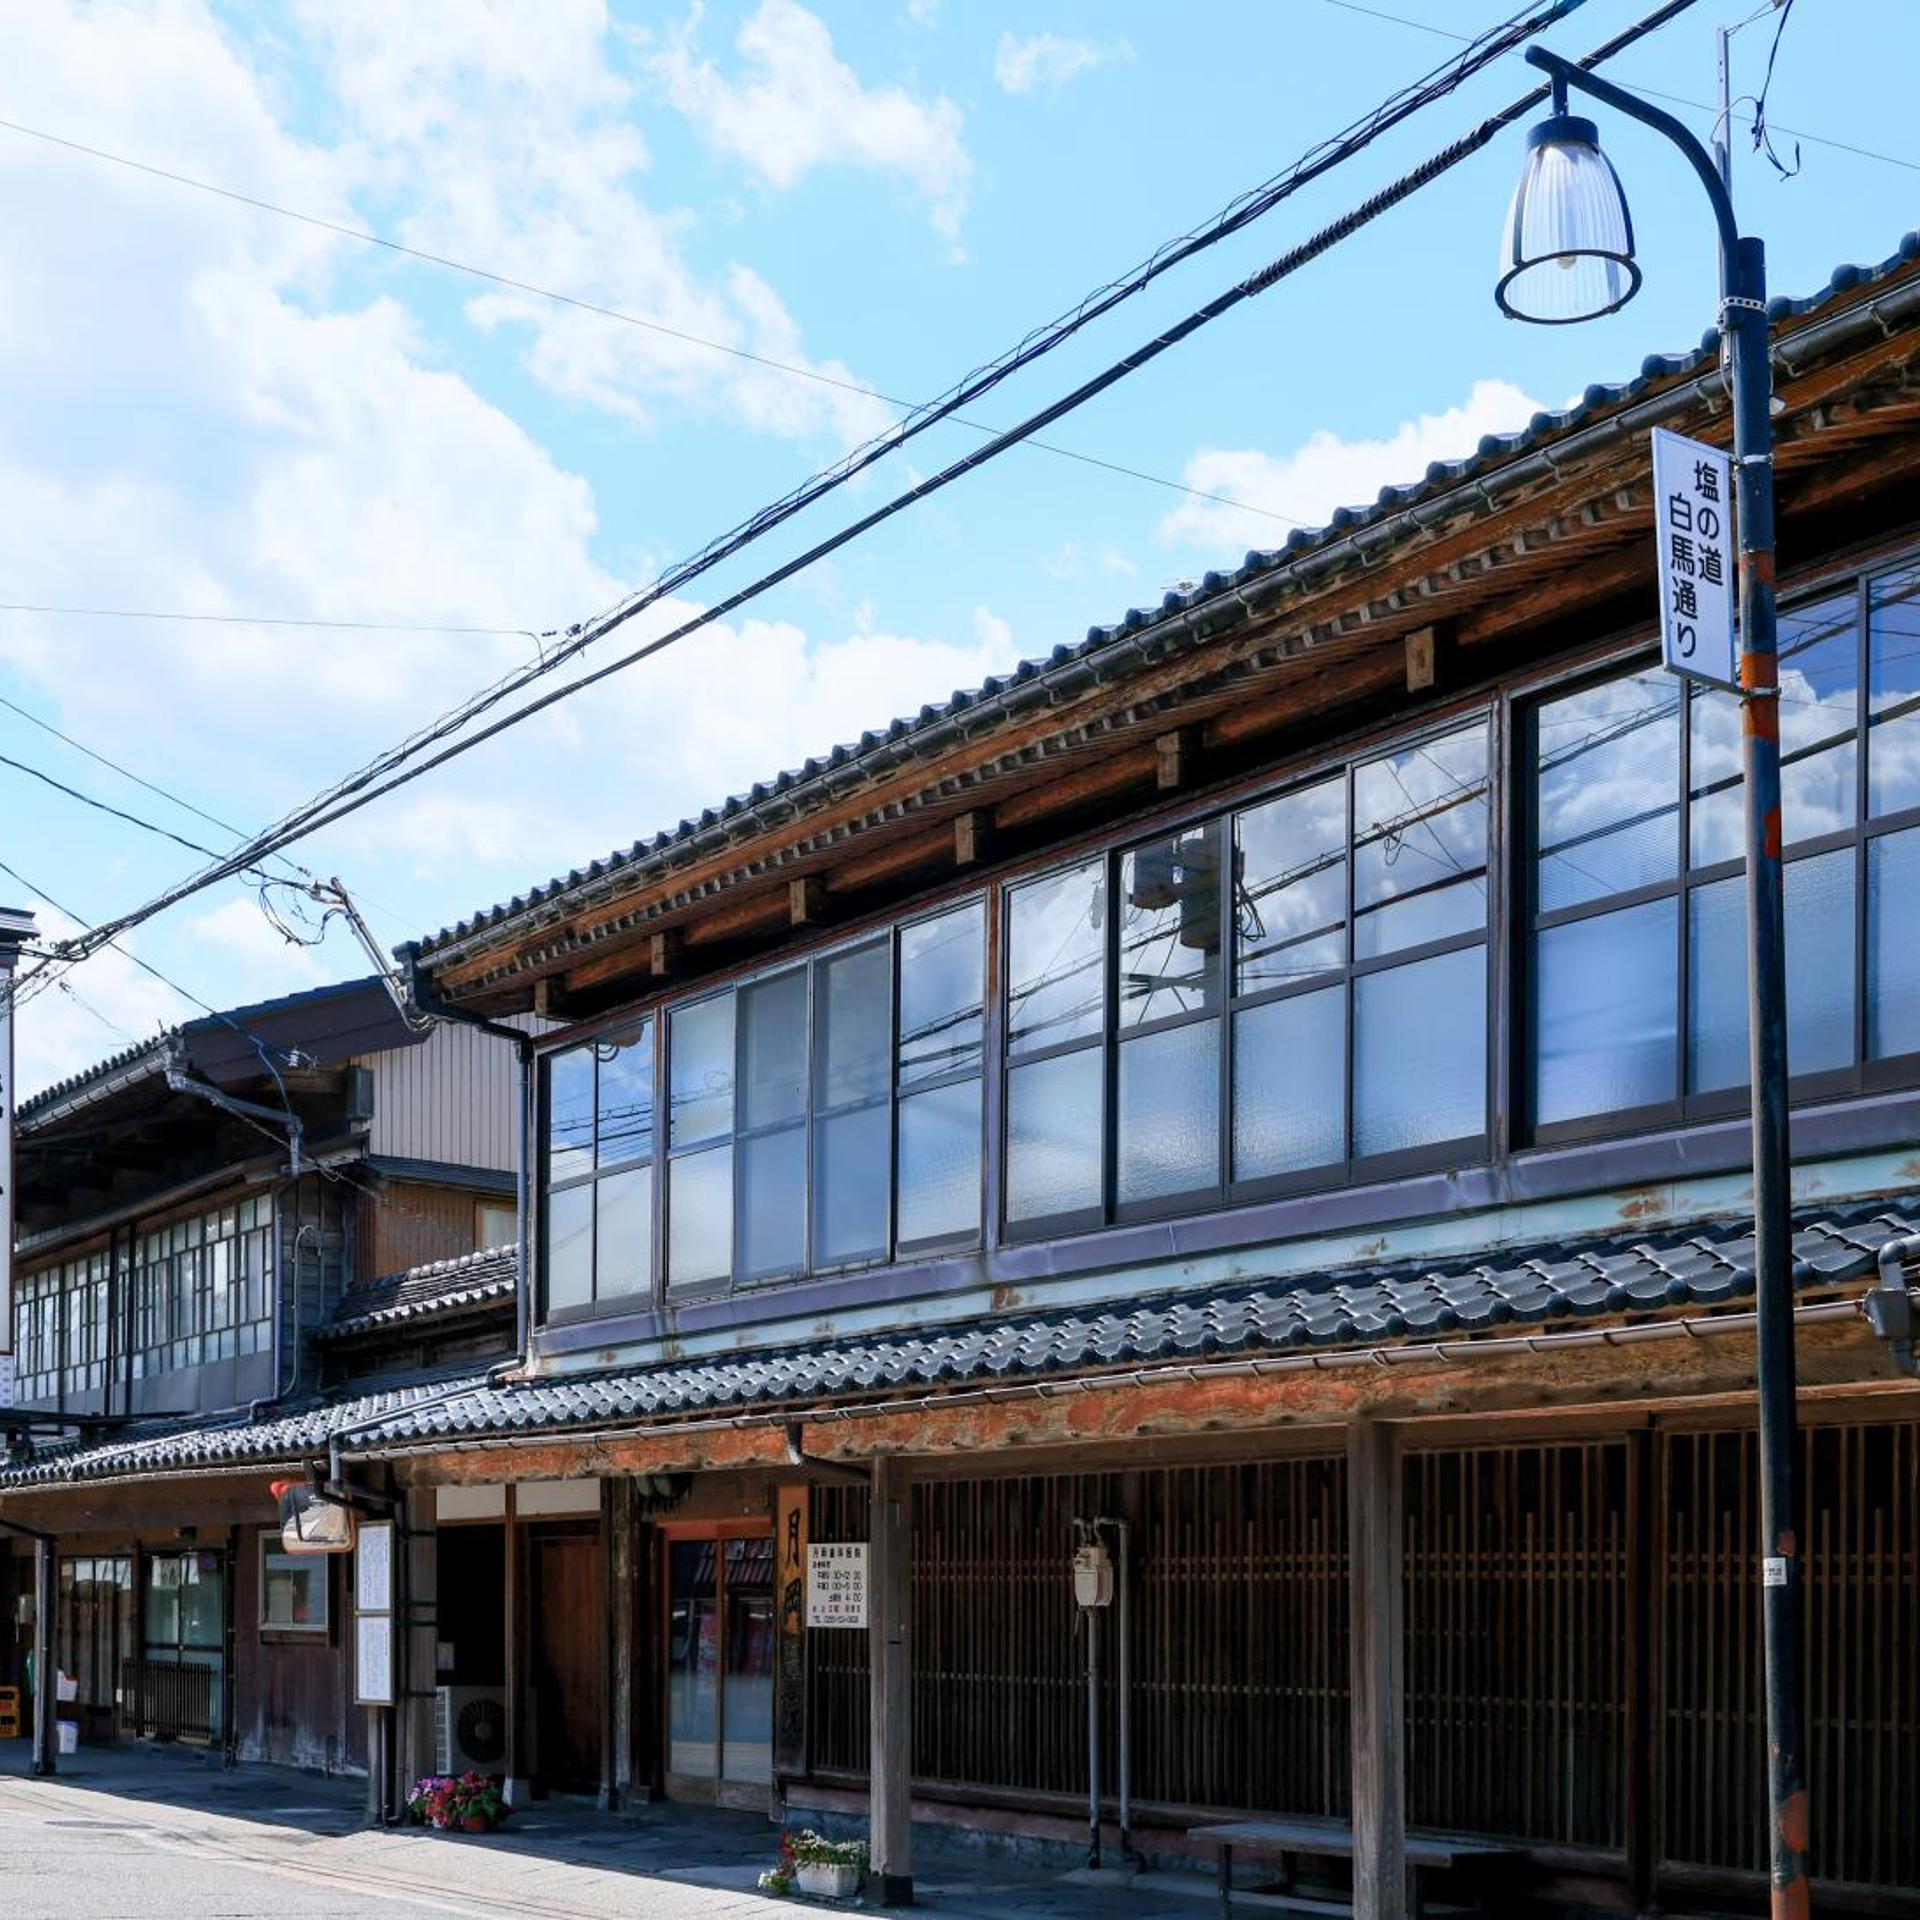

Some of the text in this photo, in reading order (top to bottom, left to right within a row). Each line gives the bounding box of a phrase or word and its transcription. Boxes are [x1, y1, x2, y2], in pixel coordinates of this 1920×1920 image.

[1669, 491, 1698, 658] 白馬通り
[1693, 459, 1723, 586] 塩の道
